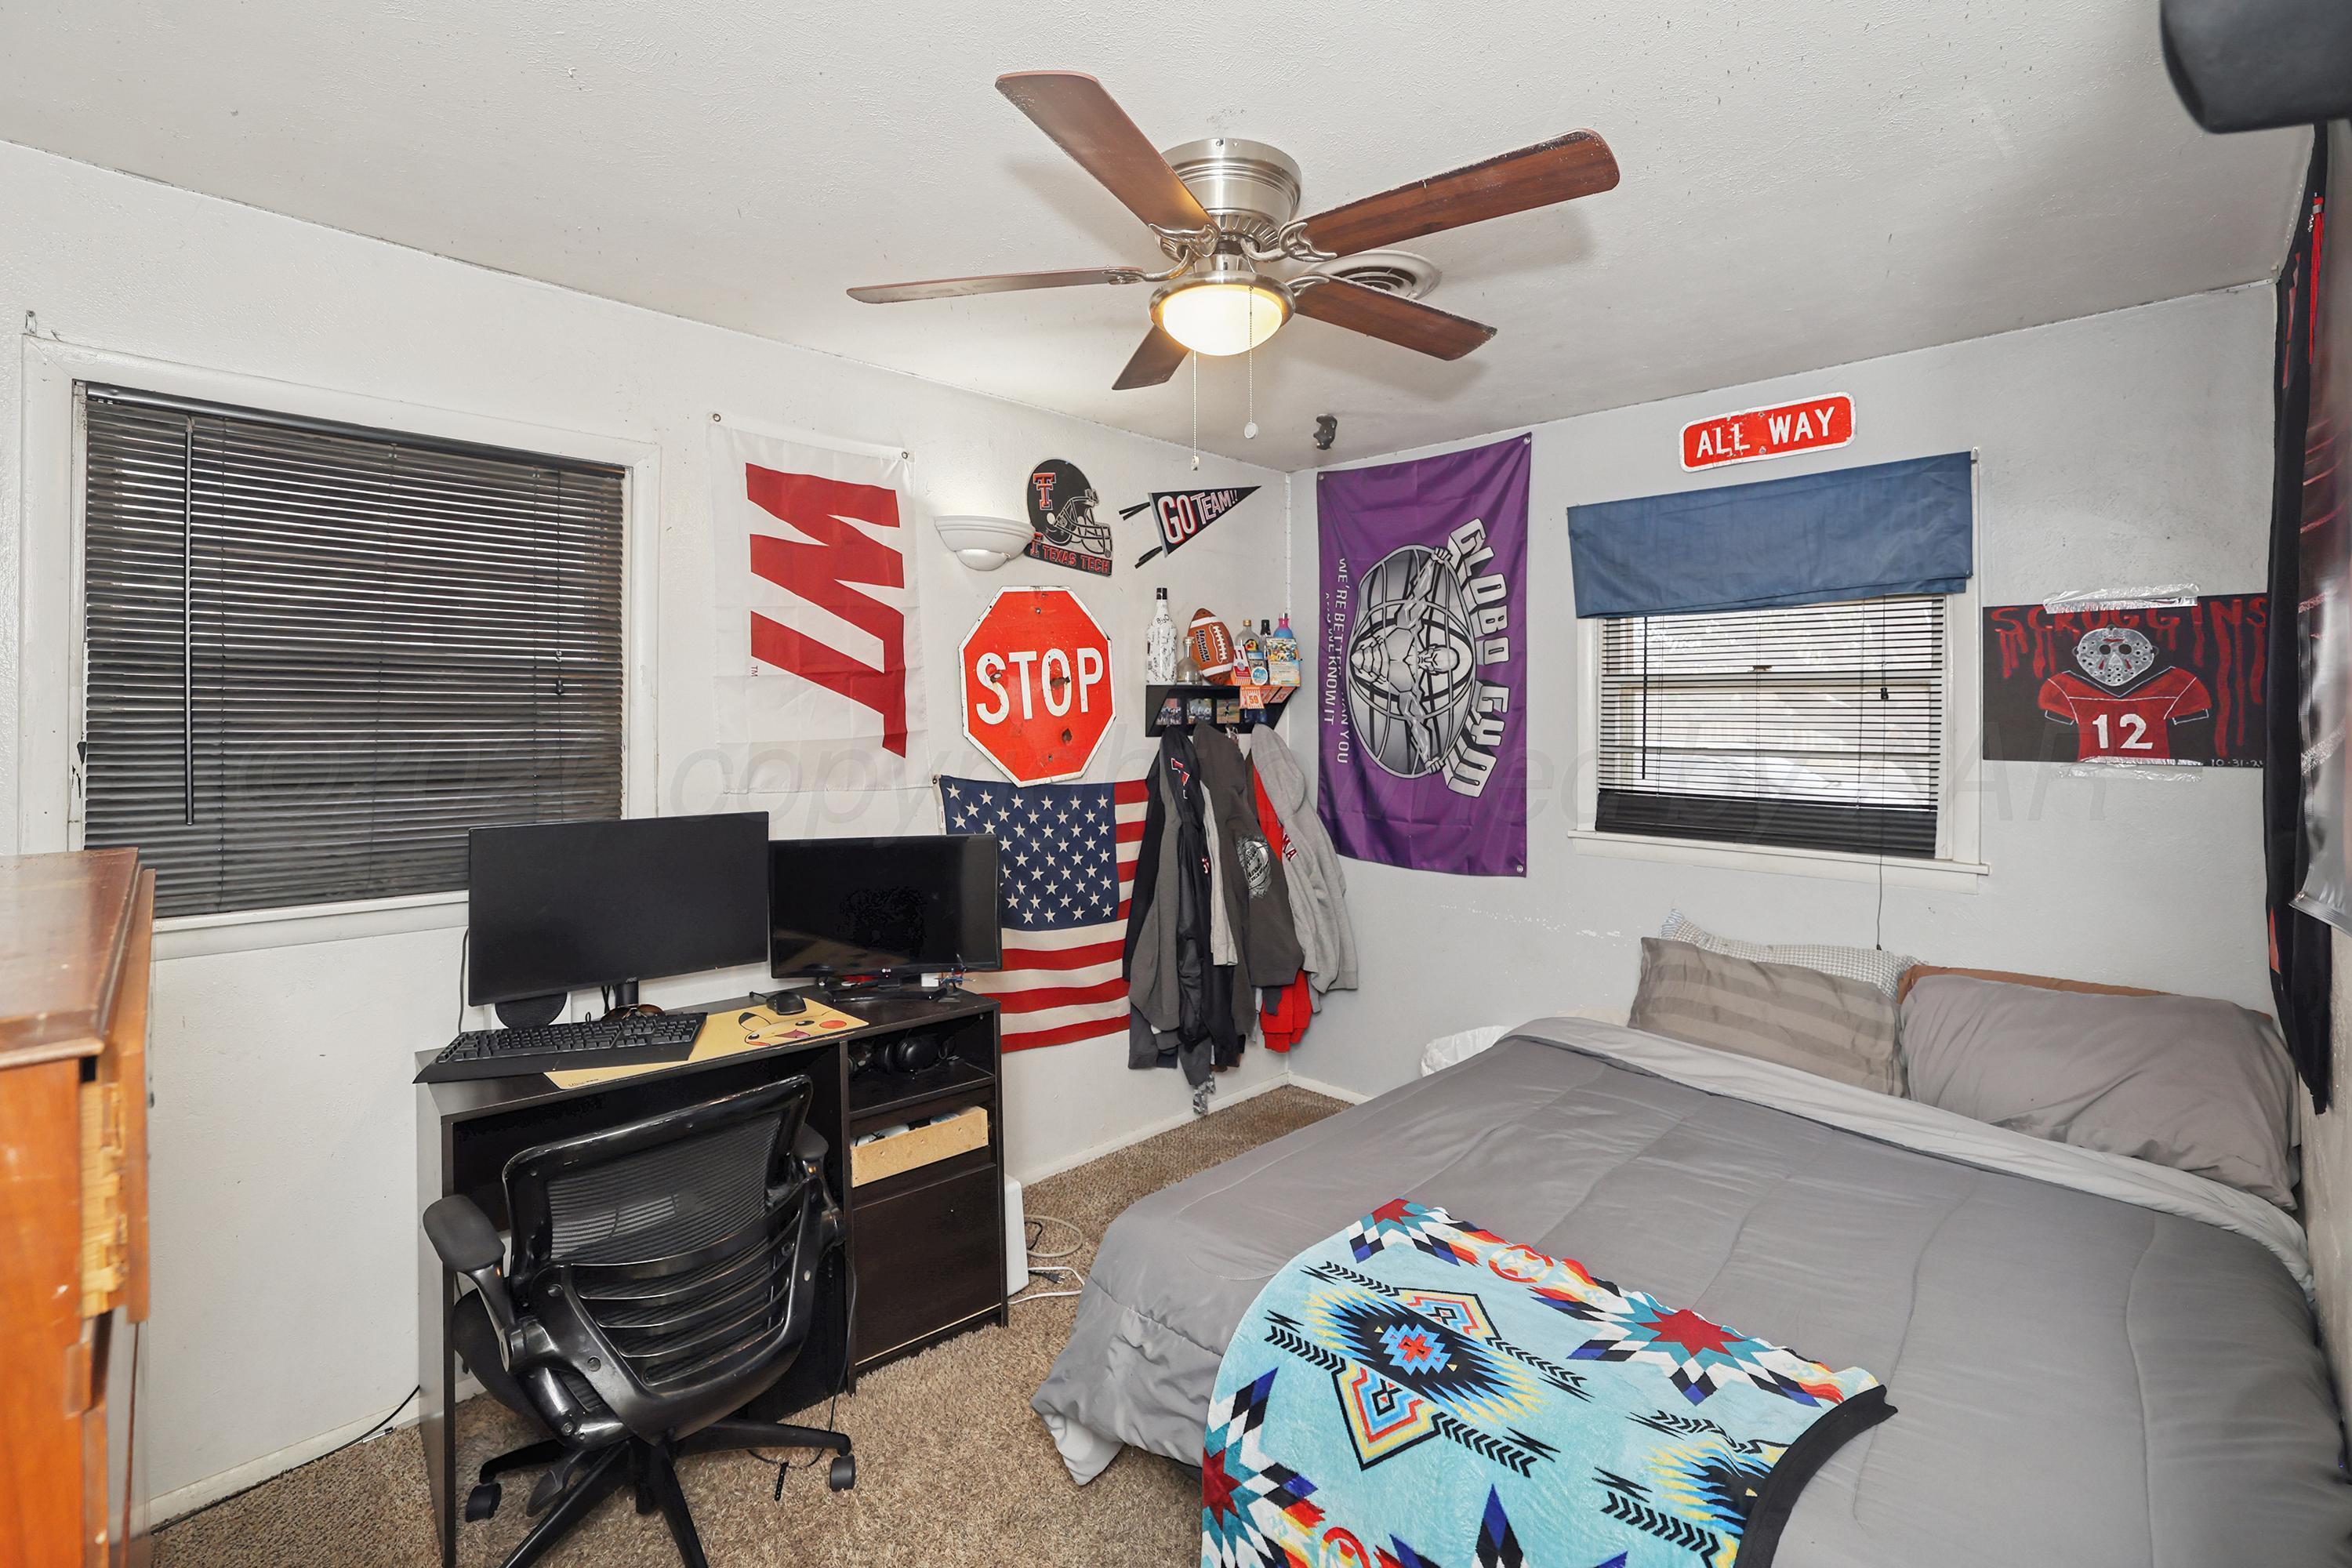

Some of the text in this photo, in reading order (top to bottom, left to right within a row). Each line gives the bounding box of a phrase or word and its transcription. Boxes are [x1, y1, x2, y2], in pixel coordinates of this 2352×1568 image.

[1696, 406, 1835, 459] ALL WAY
[1157, 489, 1239, 545] GO TEAM!!
[1043, 546, 1110, 574] TEXAS TECH
[1335, 557, 1350, 609] WE'RE
[1325, 655, 1338, 705] KNOW
[1446, 517, 1510, 798] GLOBO GYM
[975, 647, 1104, 725] STOP
[1323, 709, 1335, 726] IT
[2092, 713, 2154, 750] 12
[1337, 730, 1350, 764] YOU
